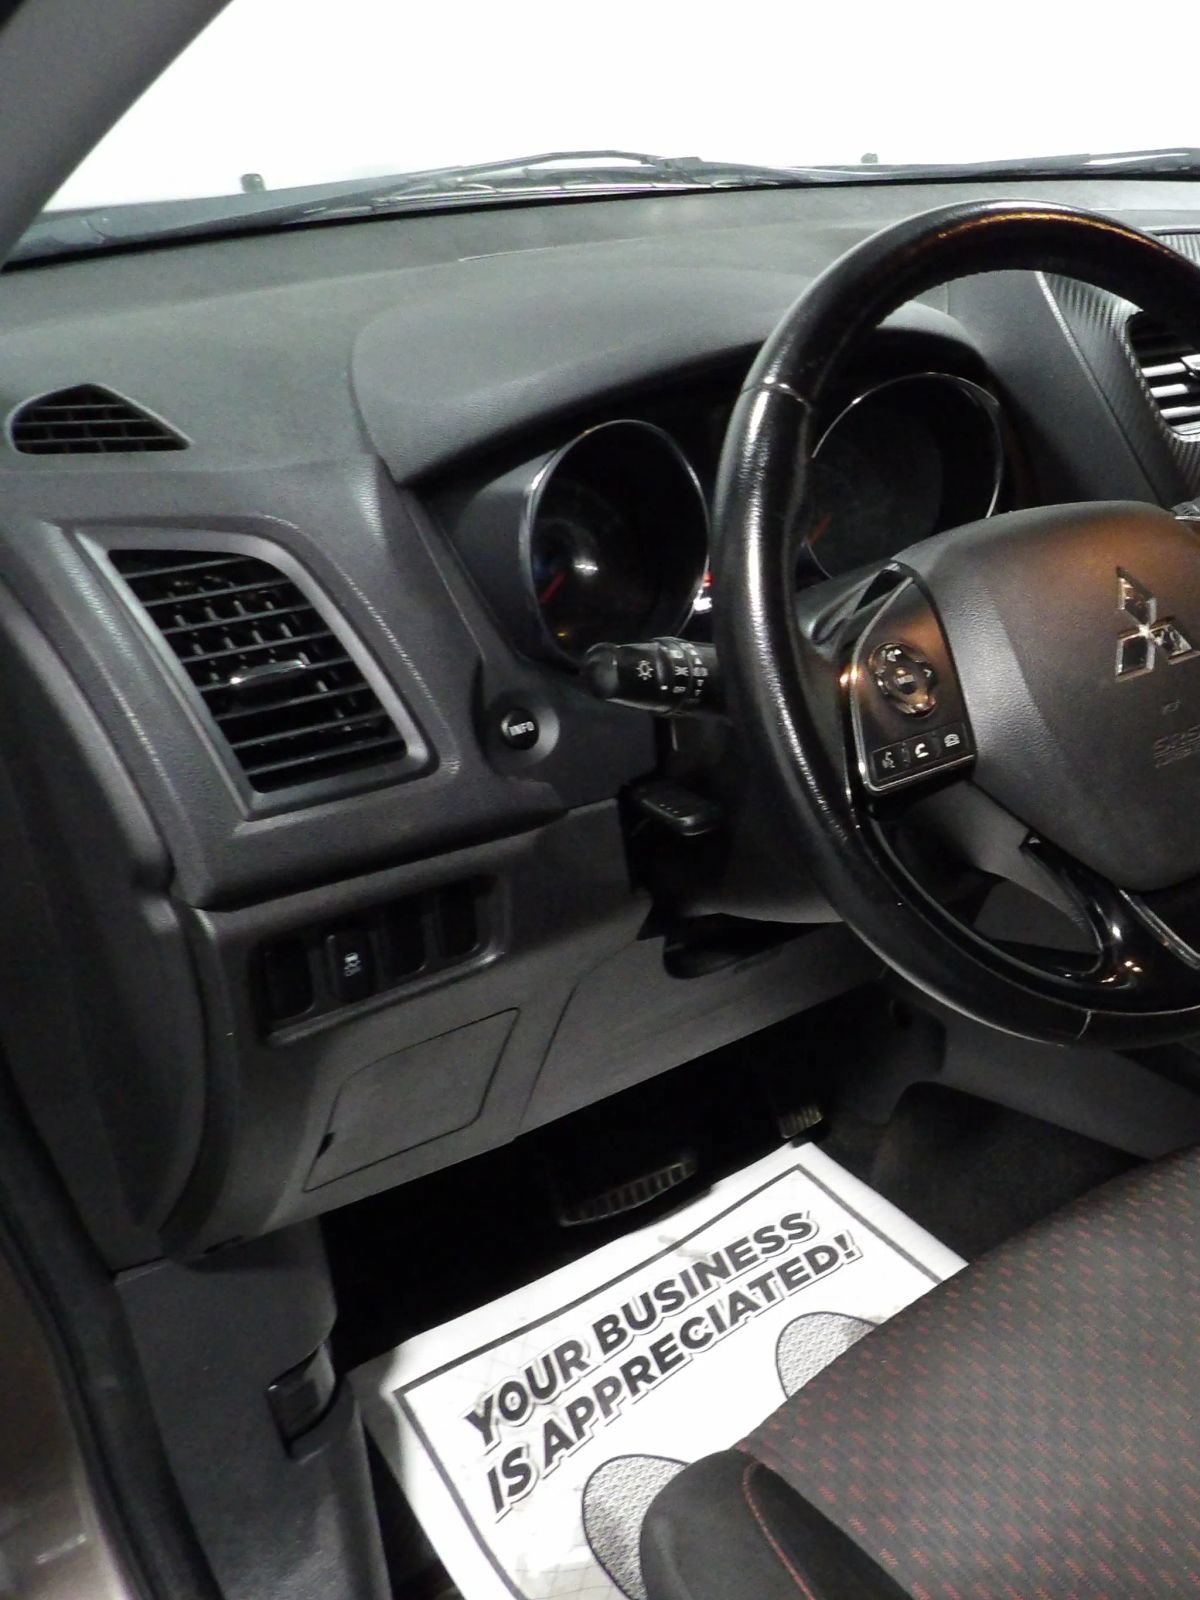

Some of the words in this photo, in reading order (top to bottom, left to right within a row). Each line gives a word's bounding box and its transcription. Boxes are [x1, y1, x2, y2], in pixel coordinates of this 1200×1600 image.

[465, 1339, 591, 1448] YOUR
[590, 1209, 820, 1357] BUSINESS
[485, 1443, 539, 1516] IS
[542, 1231, 860, 1470] APPRECIATED!
